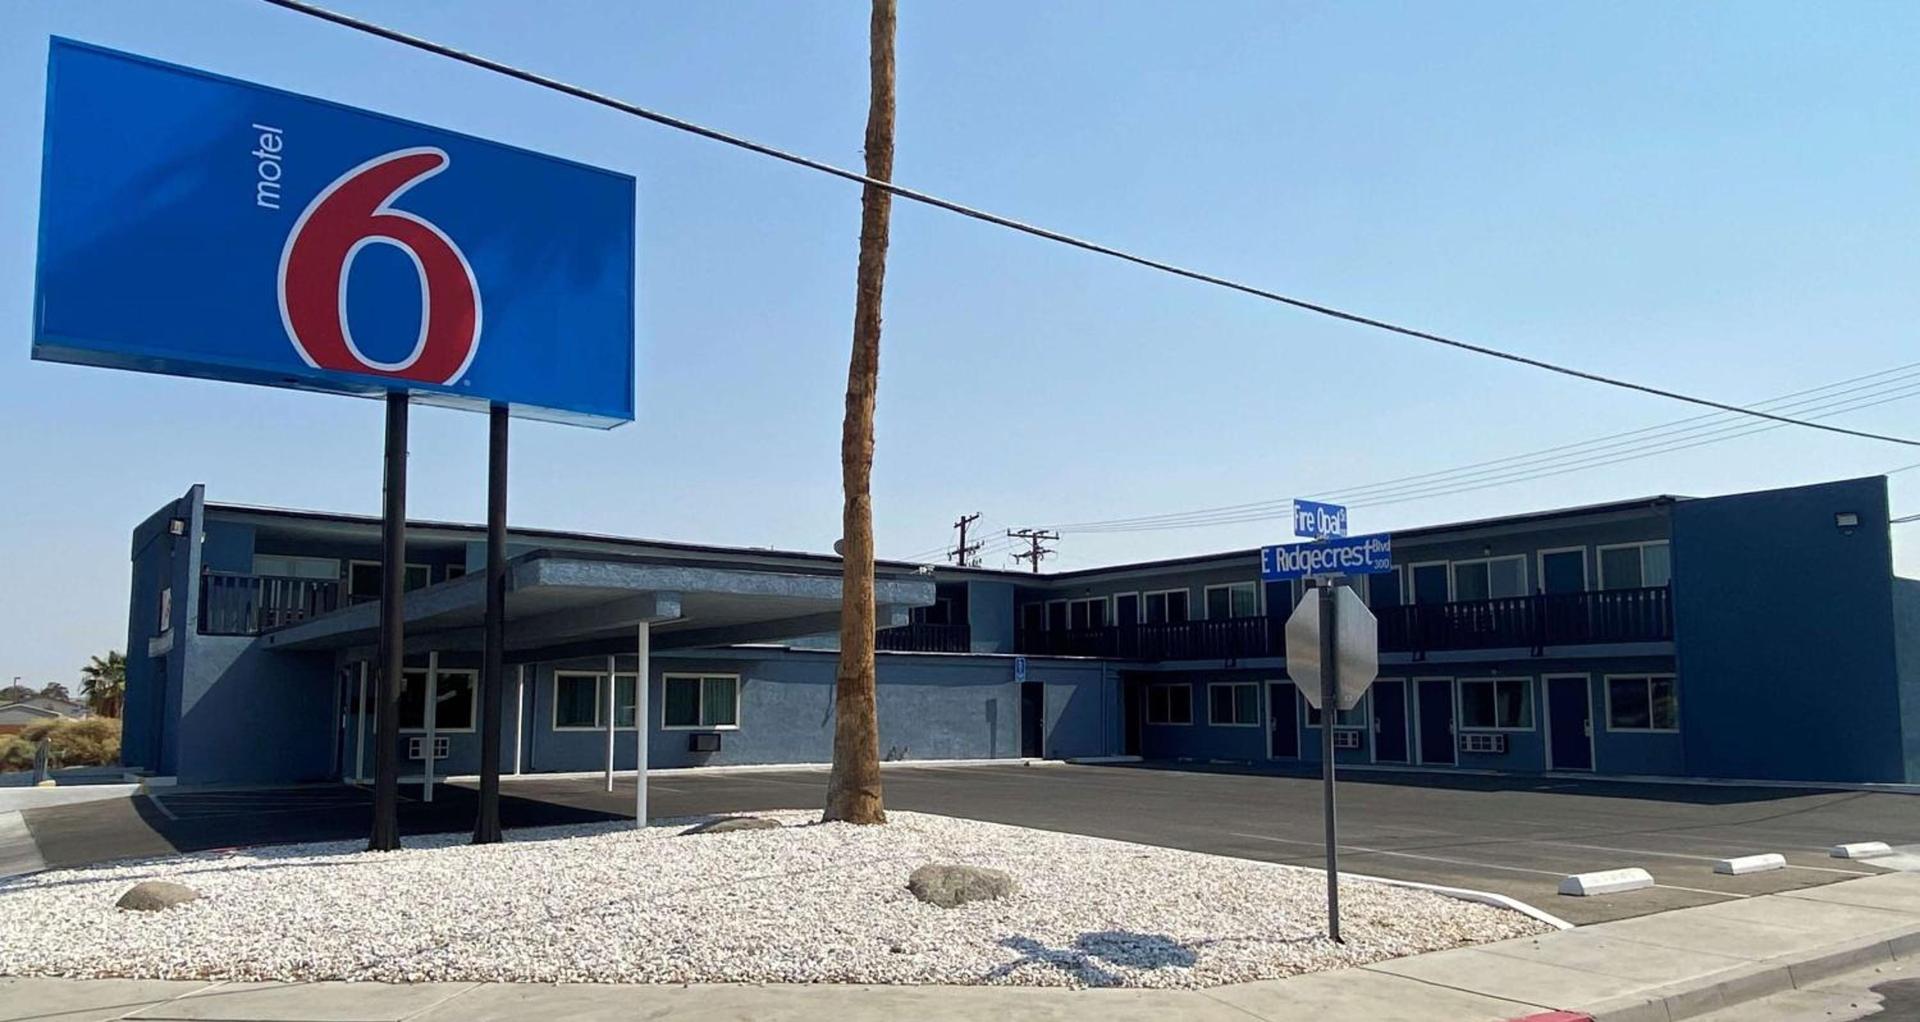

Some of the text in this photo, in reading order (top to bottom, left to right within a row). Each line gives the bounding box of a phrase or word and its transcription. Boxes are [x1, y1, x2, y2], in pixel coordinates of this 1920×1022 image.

[252, 123, 283, 209] motel
[277, 146, 483, 386] 6
[1294, 504, 1315, 532] Fire
[1317, 506, 1340, 536] Opal
[1261, 538, 1391, 575] E Ridgecrest Blvd
[1374, 558, 1390, 569] 300
